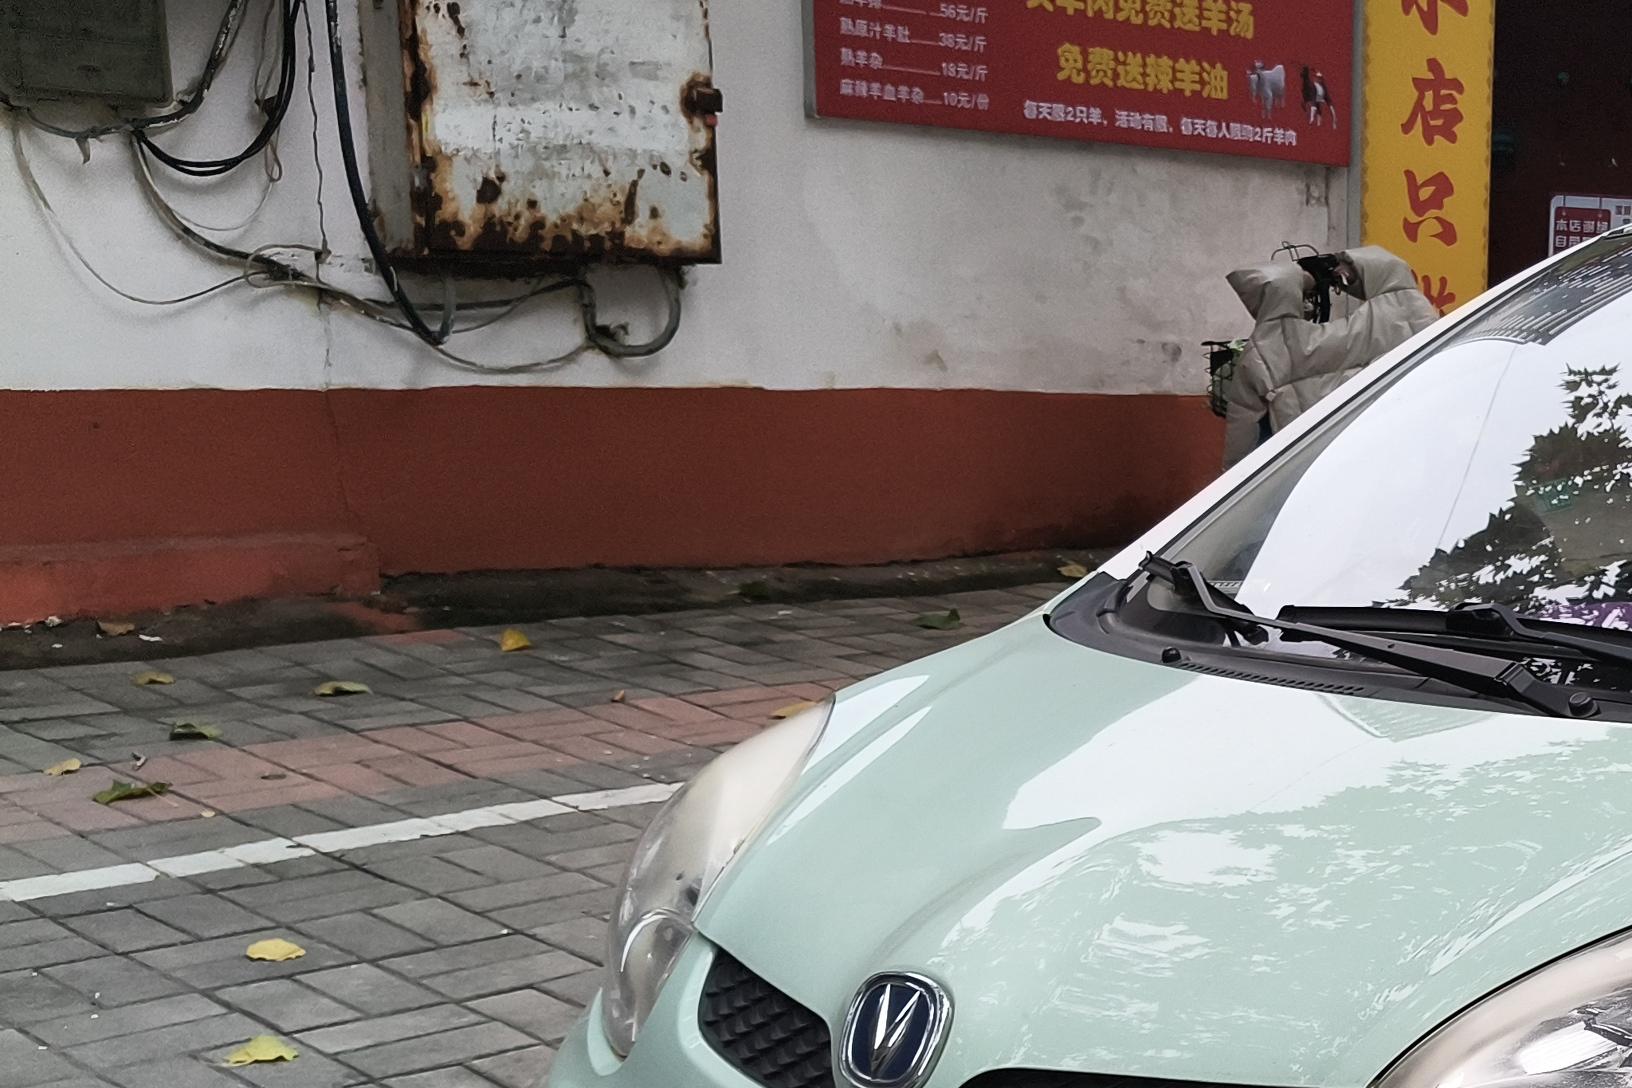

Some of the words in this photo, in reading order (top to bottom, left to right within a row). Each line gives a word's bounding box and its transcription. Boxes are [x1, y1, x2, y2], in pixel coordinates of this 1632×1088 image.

[1056, 43, 1229, 100] 免费送辣羊油
